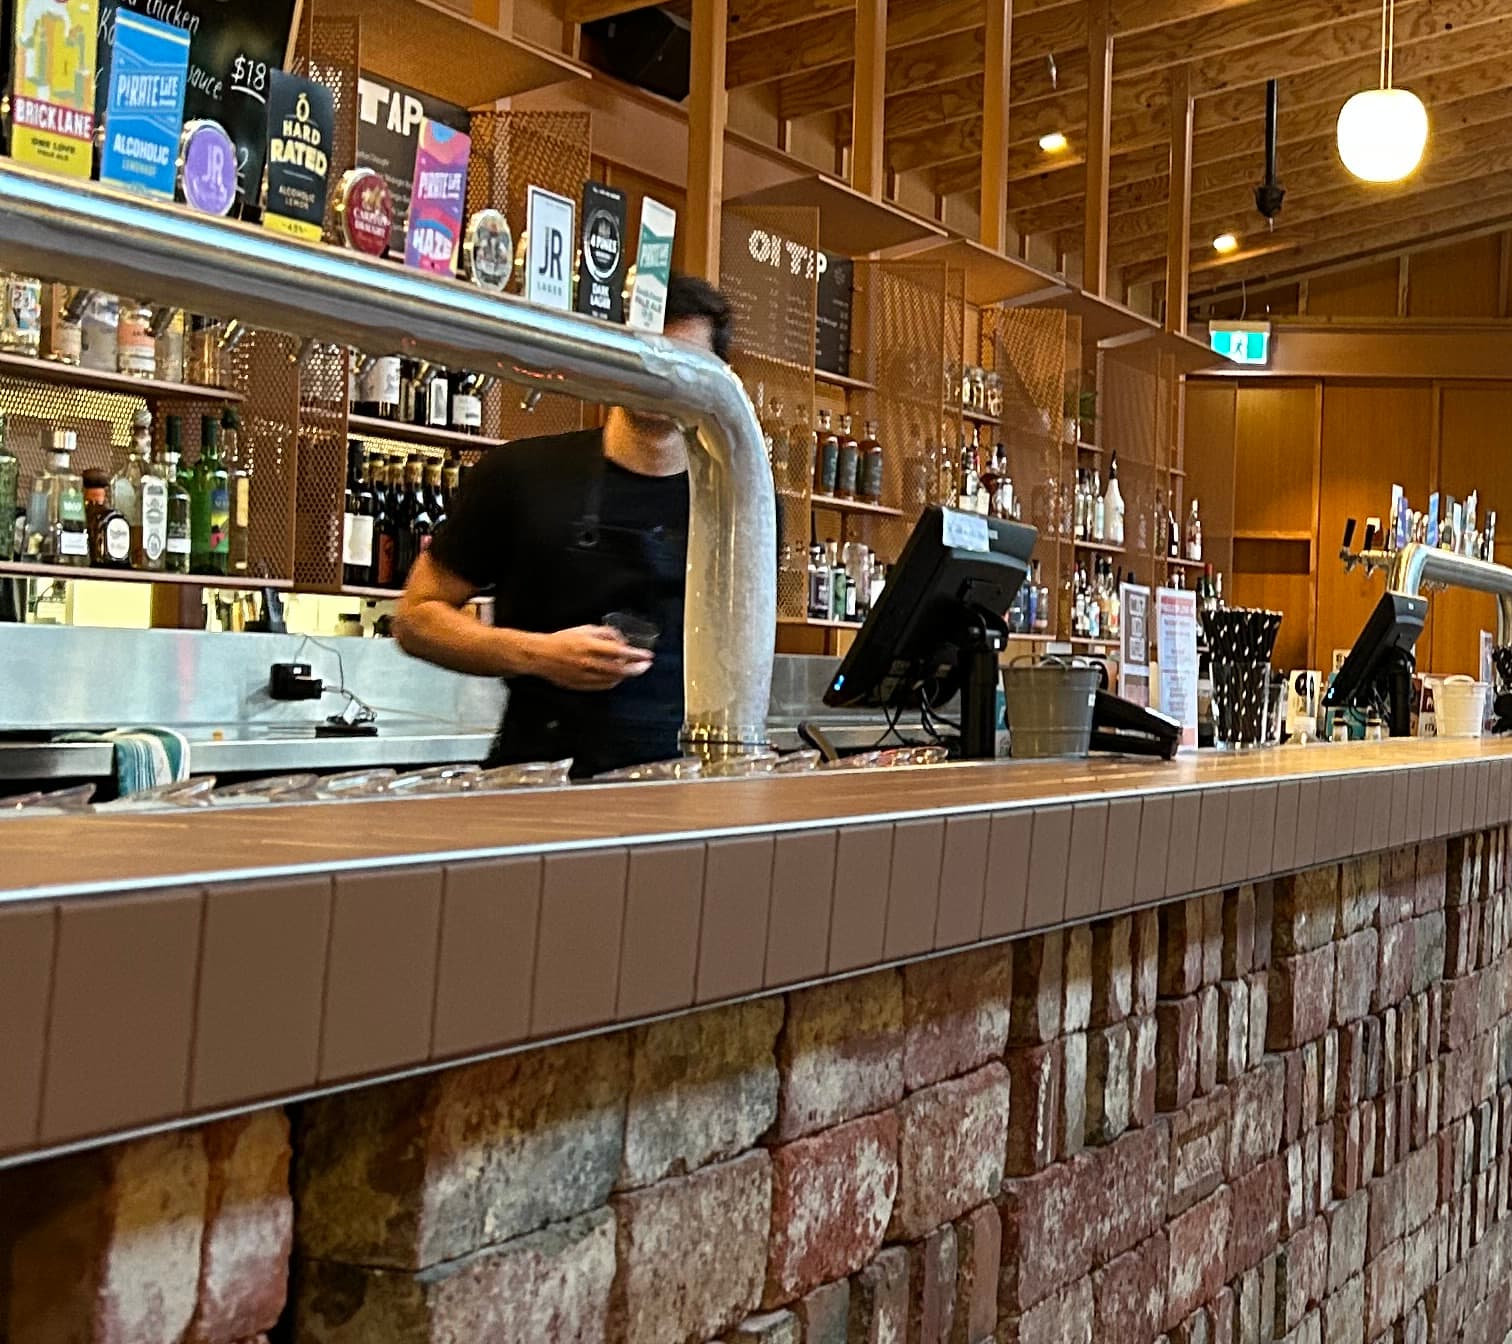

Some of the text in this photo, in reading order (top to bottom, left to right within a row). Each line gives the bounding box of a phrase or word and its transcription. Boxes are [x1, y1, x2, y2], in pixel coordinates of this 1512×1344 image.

[231, 54, 267, 91] $18
[15, 99, 92, 138] BRICK LANE
[358, 78, 423, 136] TAP
[113, 133, 169, 166] ALCOHOLIC
[283, 120, 321, 145] HARD
[270, 138, 328, 177] RATED
[539, 227, 563, 281] JR
